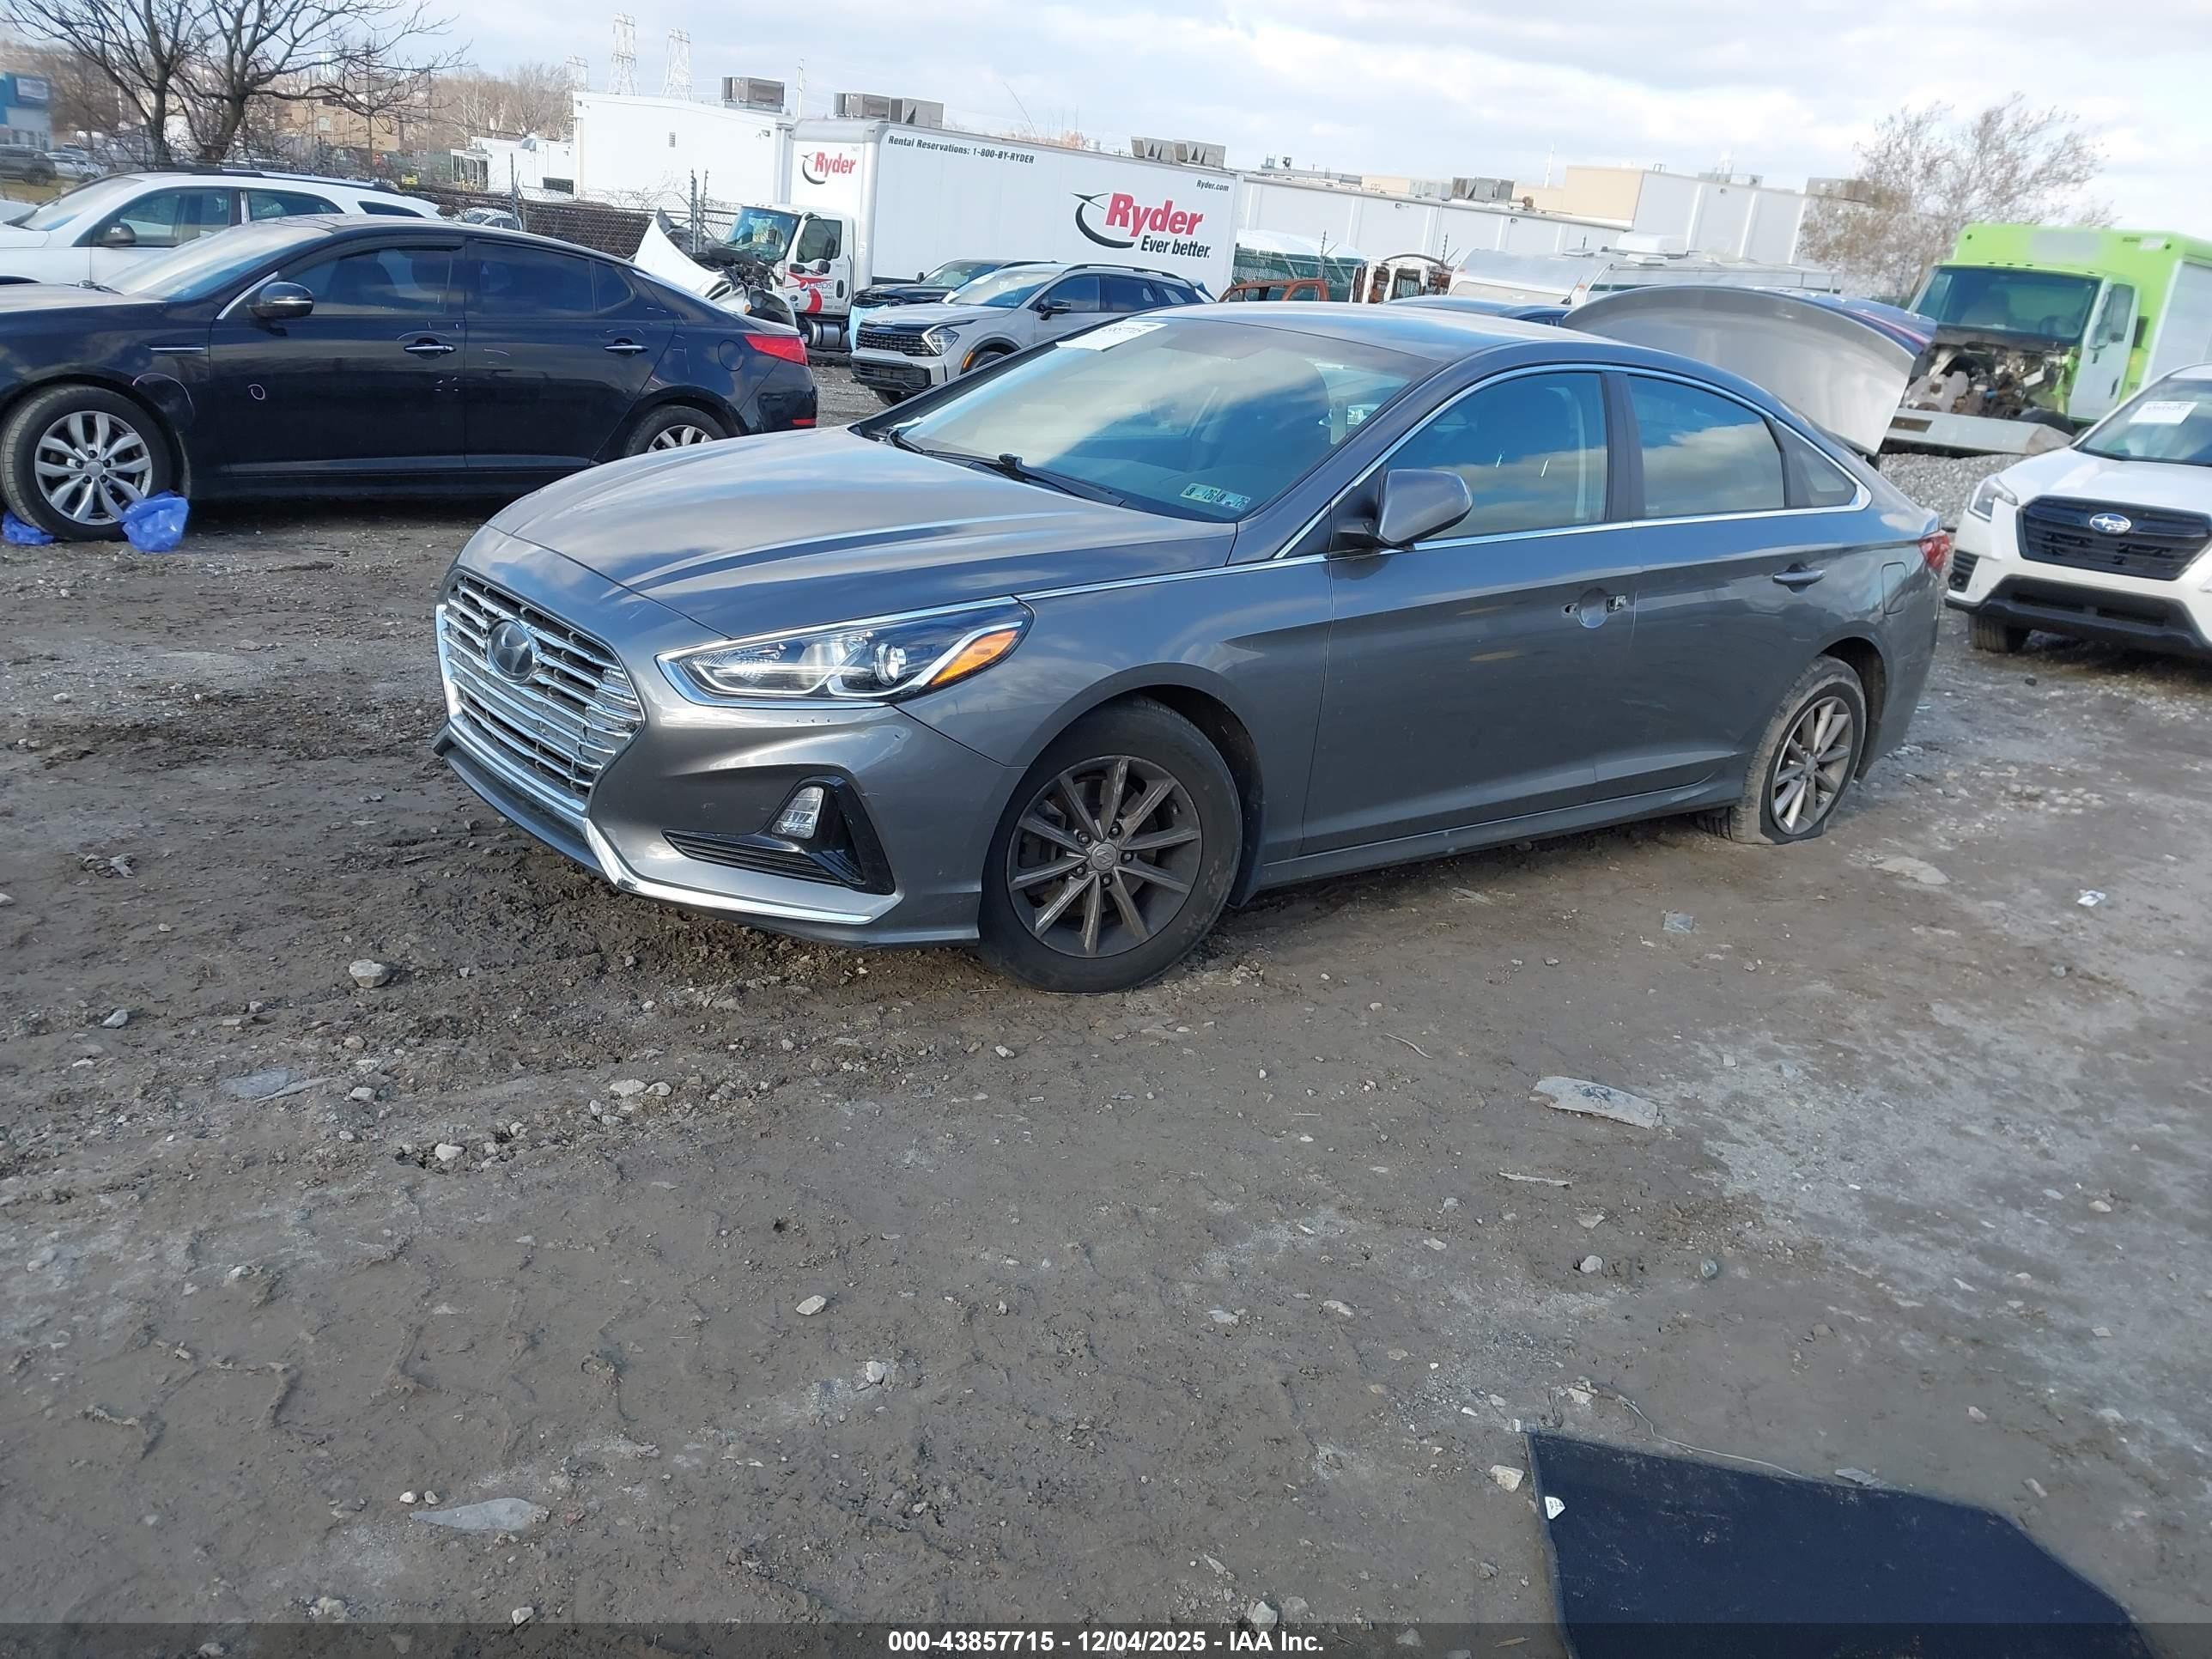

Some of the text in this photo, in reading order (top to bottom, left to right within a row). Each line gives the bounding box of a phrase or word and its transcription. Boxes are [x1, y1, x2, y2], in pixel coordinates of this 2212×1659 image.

[888, 135, 1035, 164] Rental Reservations: 1-800-BY-RYDER
[814, 152, 857, 178] Ryder
[1196, 179, 1230, 192] Ryder.com
[1105, 191, 1204, 238] Ryder
[1140, 234, 1212, 258] Ever better.
